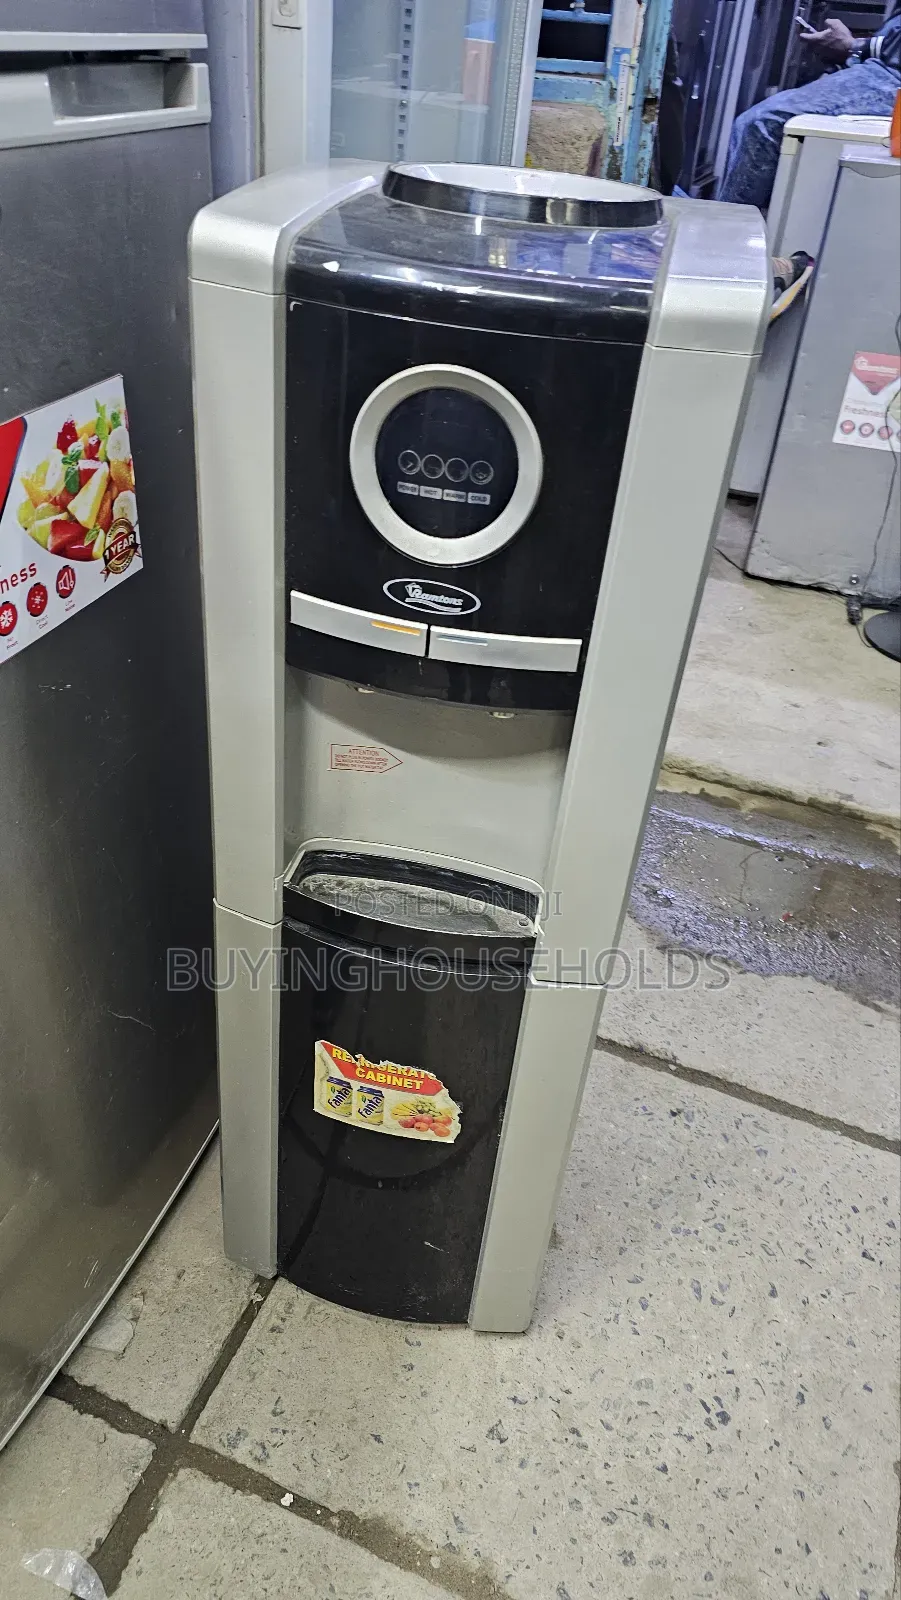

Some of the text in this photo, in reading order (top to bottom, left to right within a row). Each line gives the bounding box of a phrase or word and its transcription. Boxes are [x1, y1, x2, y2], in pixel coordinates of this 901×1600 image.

[470, 495, 488, 503] COLD
[104, 533, 135, 560] 1 YEAR
[405, 583, 464, 606] Ramtons
[349, 748, 379, 756] ATTENTION
[355, 1067, 424, 1090] CABINET
